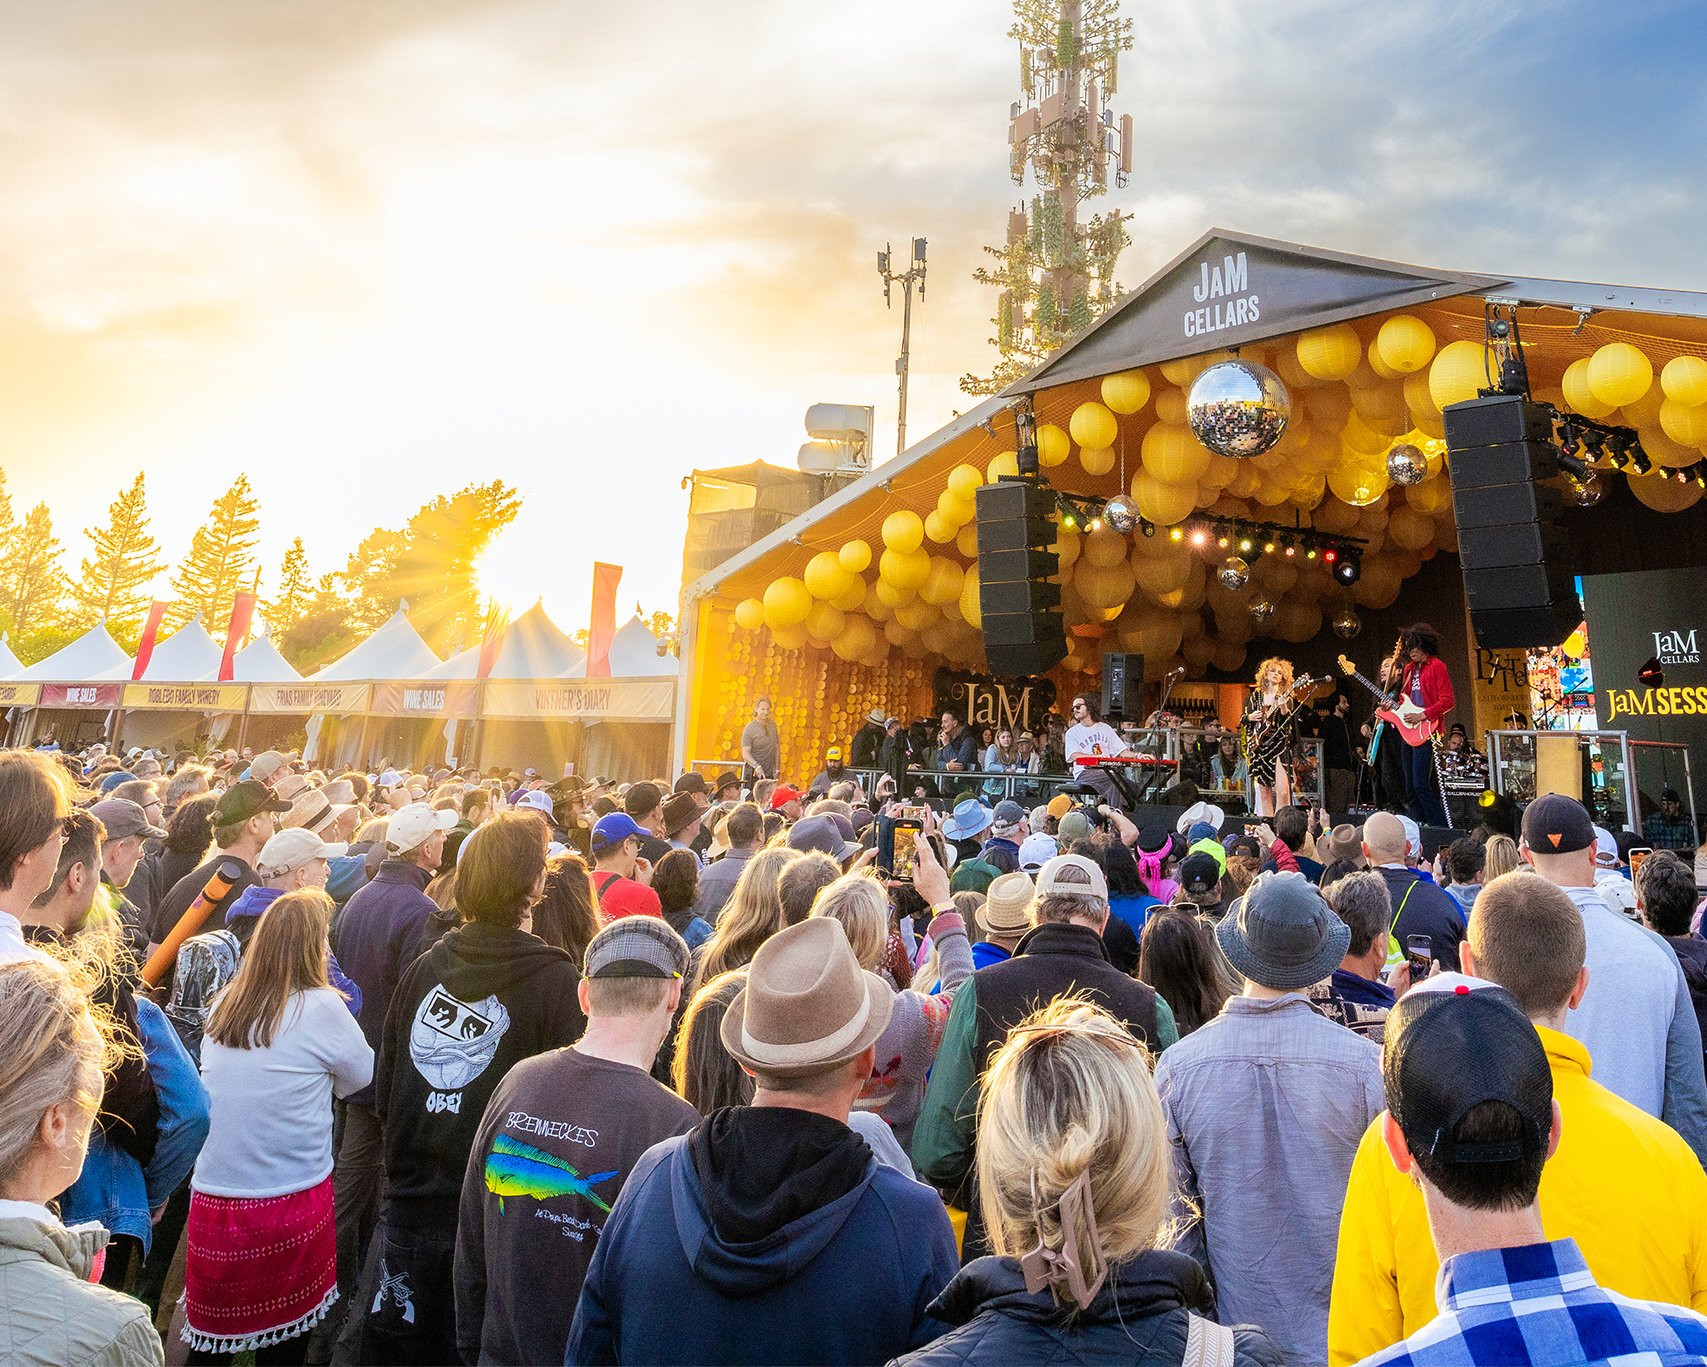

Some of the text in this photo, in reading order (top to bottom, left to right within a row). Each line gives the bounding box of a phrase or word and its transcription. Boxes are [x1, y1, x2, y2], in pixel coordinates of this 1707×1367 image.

[1184, 294, 1260, 338] CELLARS
[1651, 629, 1700, 660] JaM
[1660, 655, 1700, 664] CELLARS
[65, 687, 97, 703] WINE SALES
[148, 688, 221, 705] ROBLEDO FAMILY WINERY
[276, 689, 294, 706] FRIAS
[293, 689, 313, 706] FAMILY
[403, 689, 445, 710] WINE SALES
[535, 688, 611, 710] VINTNER'S DIARY
[426, 1091, 463, 1114] OBEY
